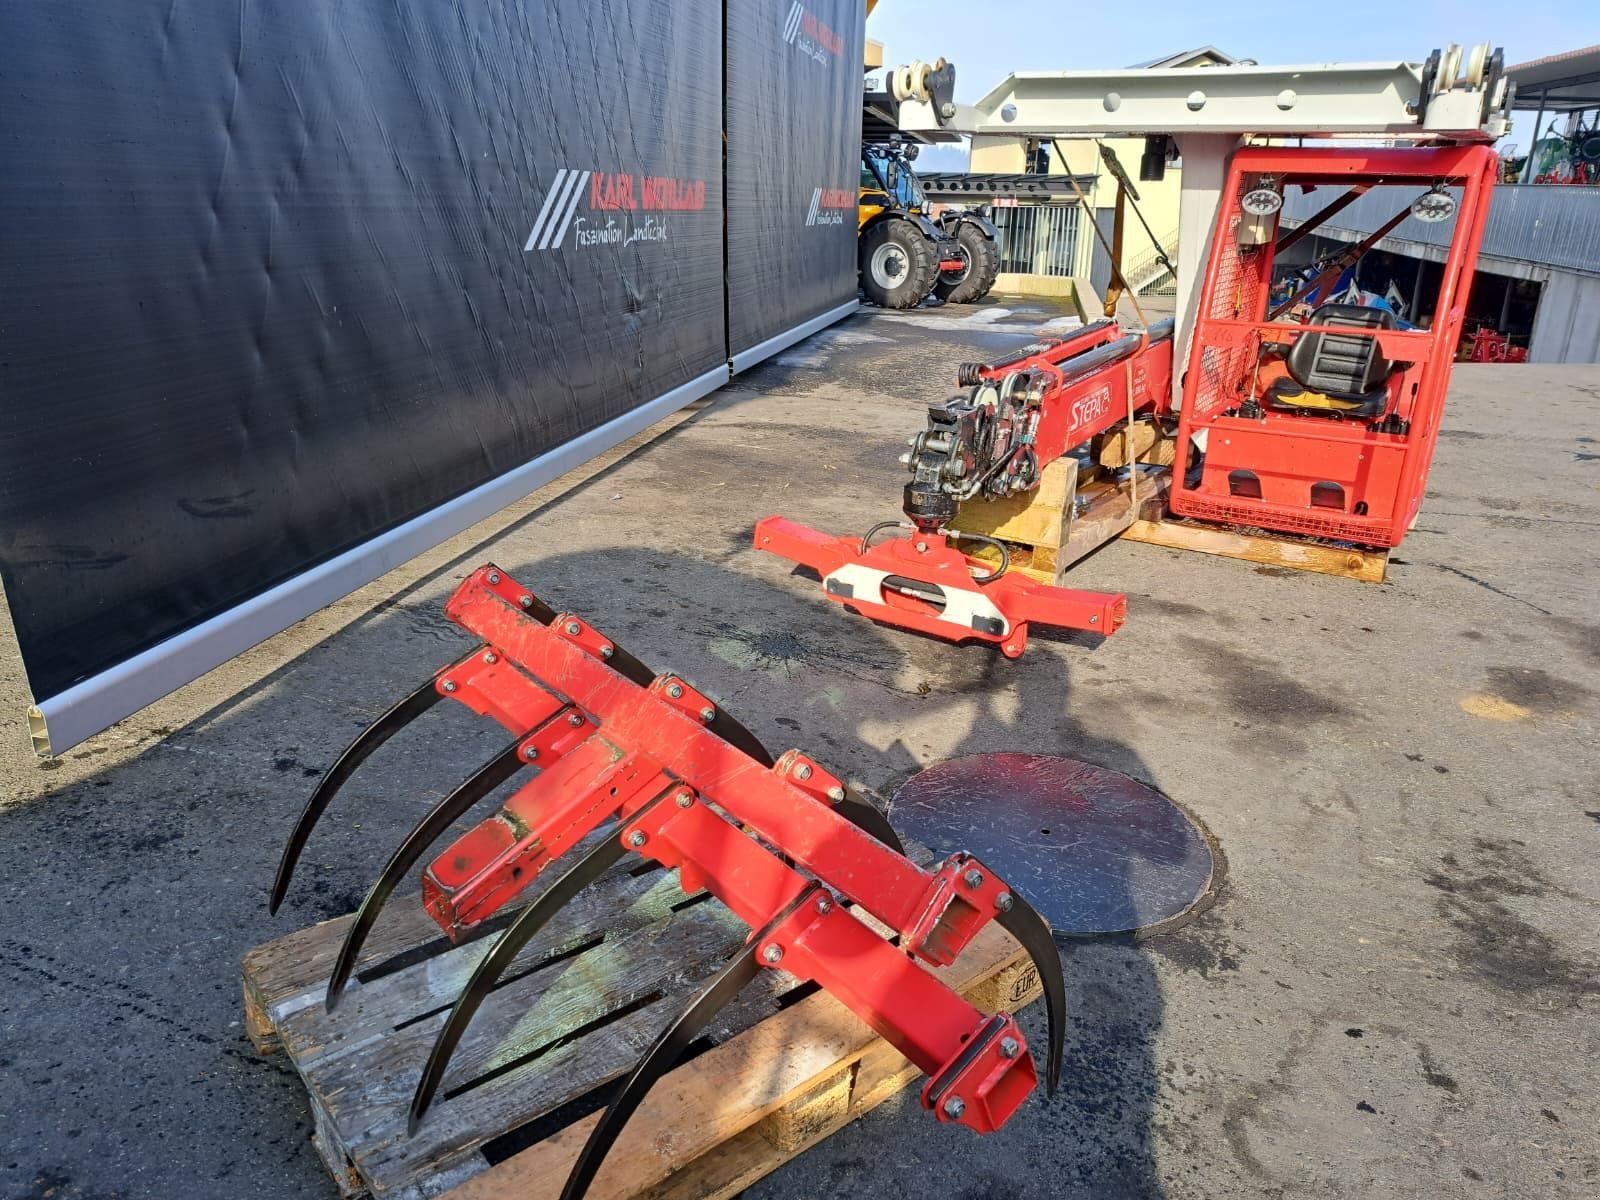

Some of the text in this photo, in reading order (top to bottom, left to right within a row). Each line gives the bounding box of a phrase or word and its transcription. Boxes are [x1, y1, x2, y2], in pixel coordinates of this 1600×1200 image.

[590, 172, 637, 210] KARL
[1069, 396, 1101, 432] STEPA
[1016, 969, 1036, 998] EUR
